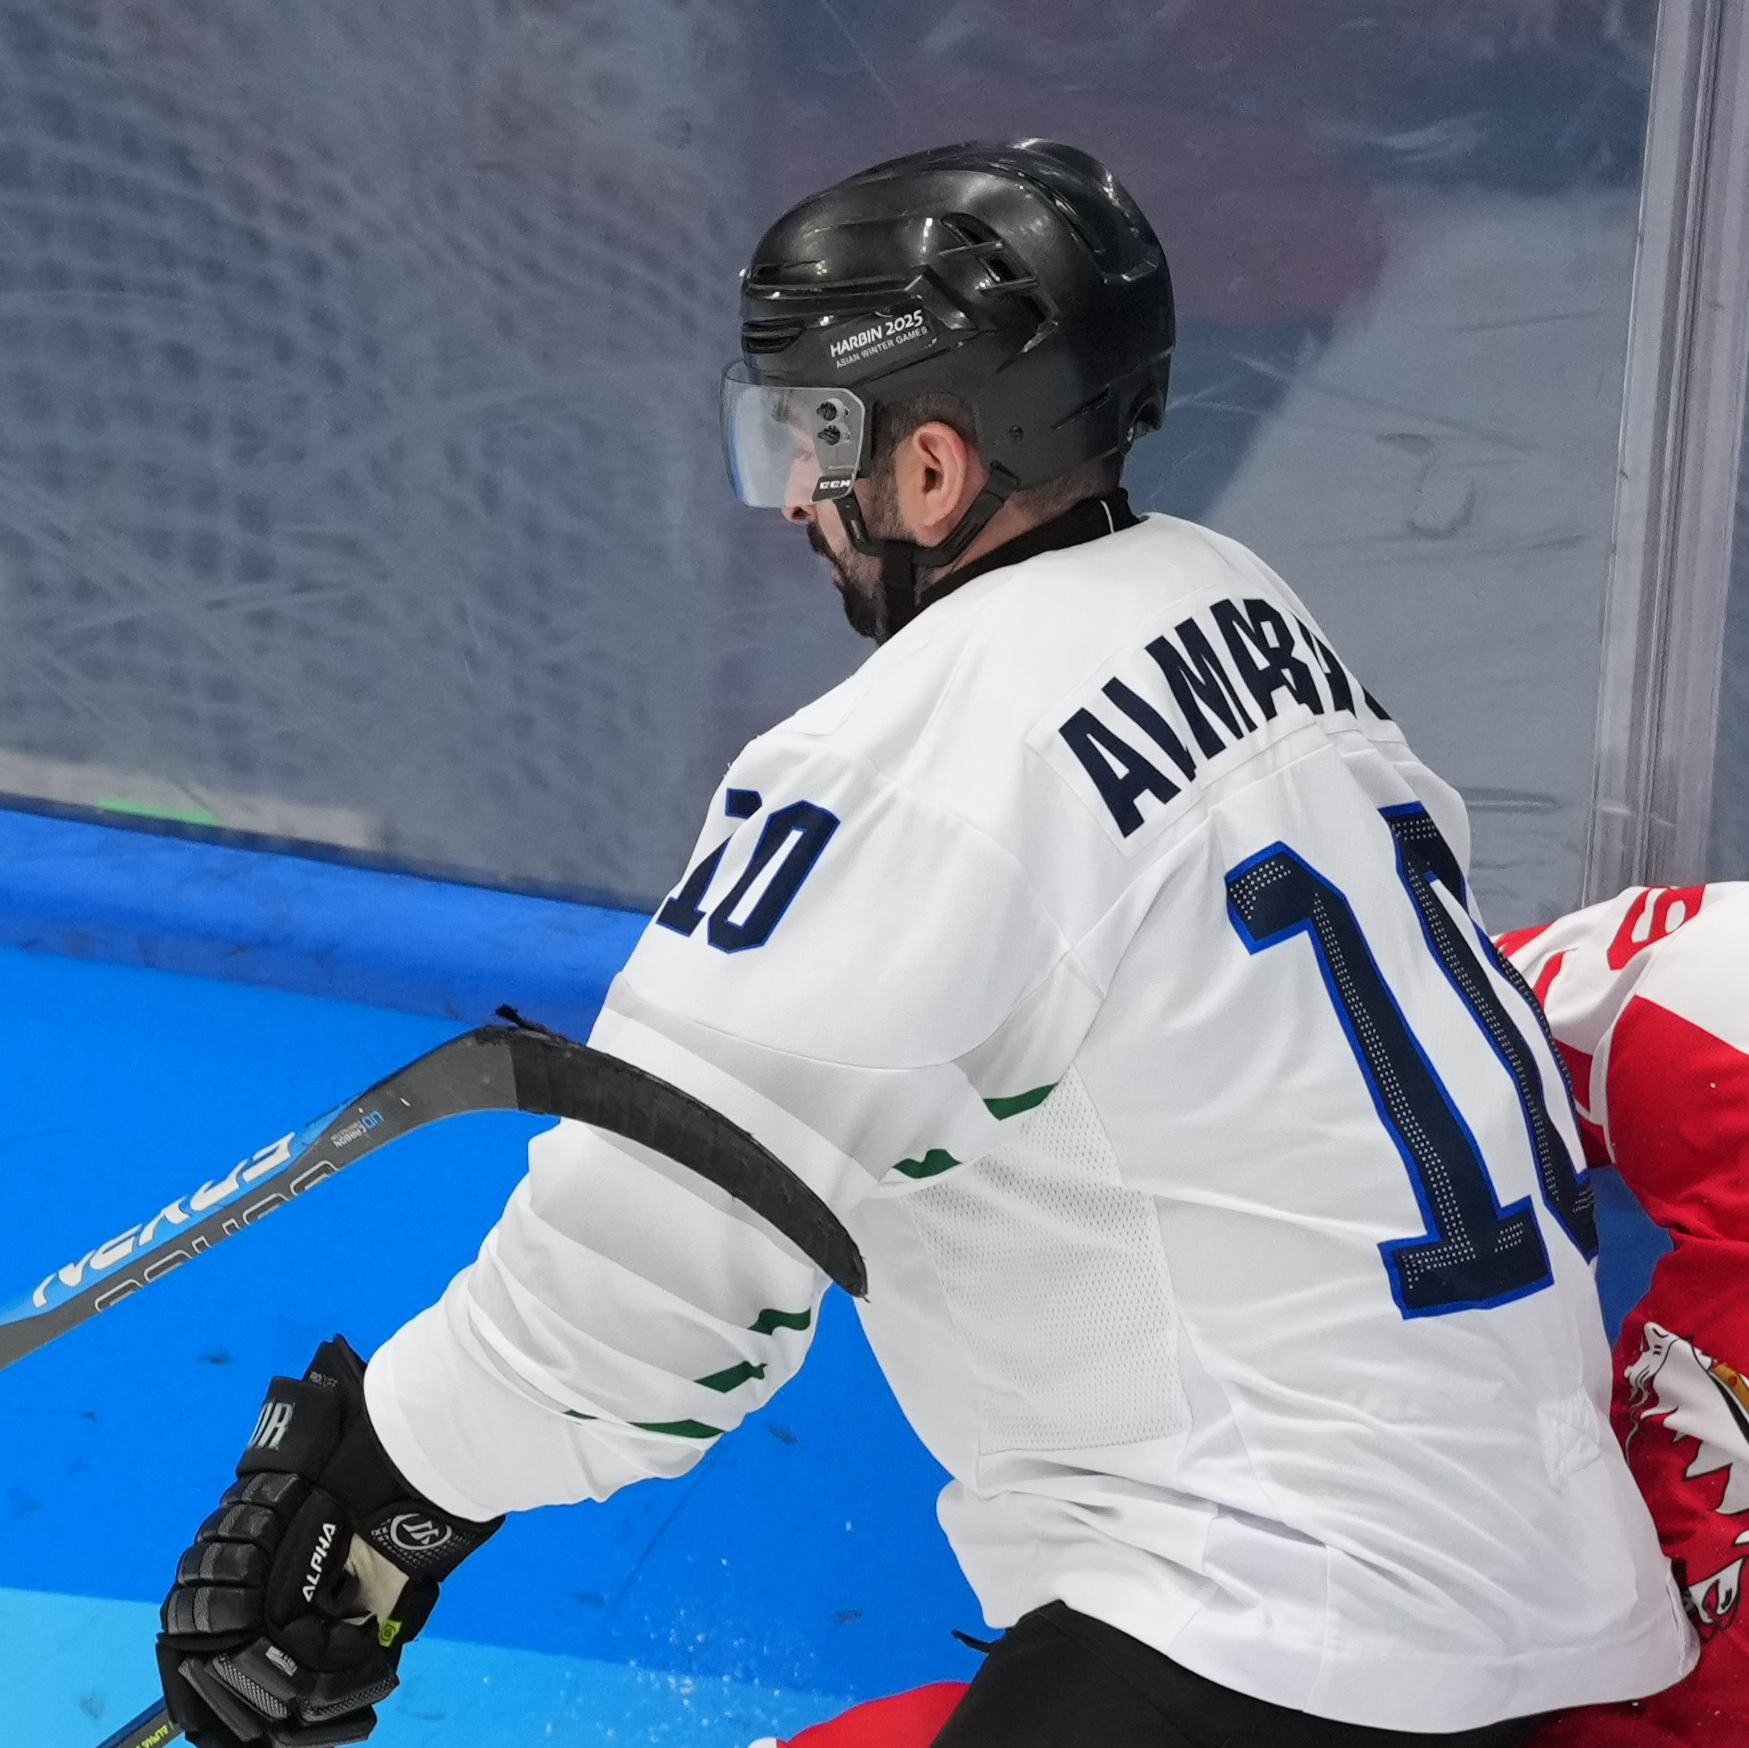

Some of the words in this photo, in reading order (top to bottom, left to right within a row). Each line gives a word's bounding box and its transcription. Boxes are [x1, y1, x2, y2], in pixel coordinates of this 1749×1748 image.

[830, 325, 883, 358] HARBIN
[885, 310, 923, 336] 2025
[836, 352, 860, 369] ASIAN
[860, 338, 894, 358] WINTER
[895, 326, 928, 344] GAMES
[819, 480, 851, 489] CCM
[656, 787, 841, 954] 10
[1224, 801, 1600, 1320] 10
[302, 1522, 337, 1603] ALPHA
